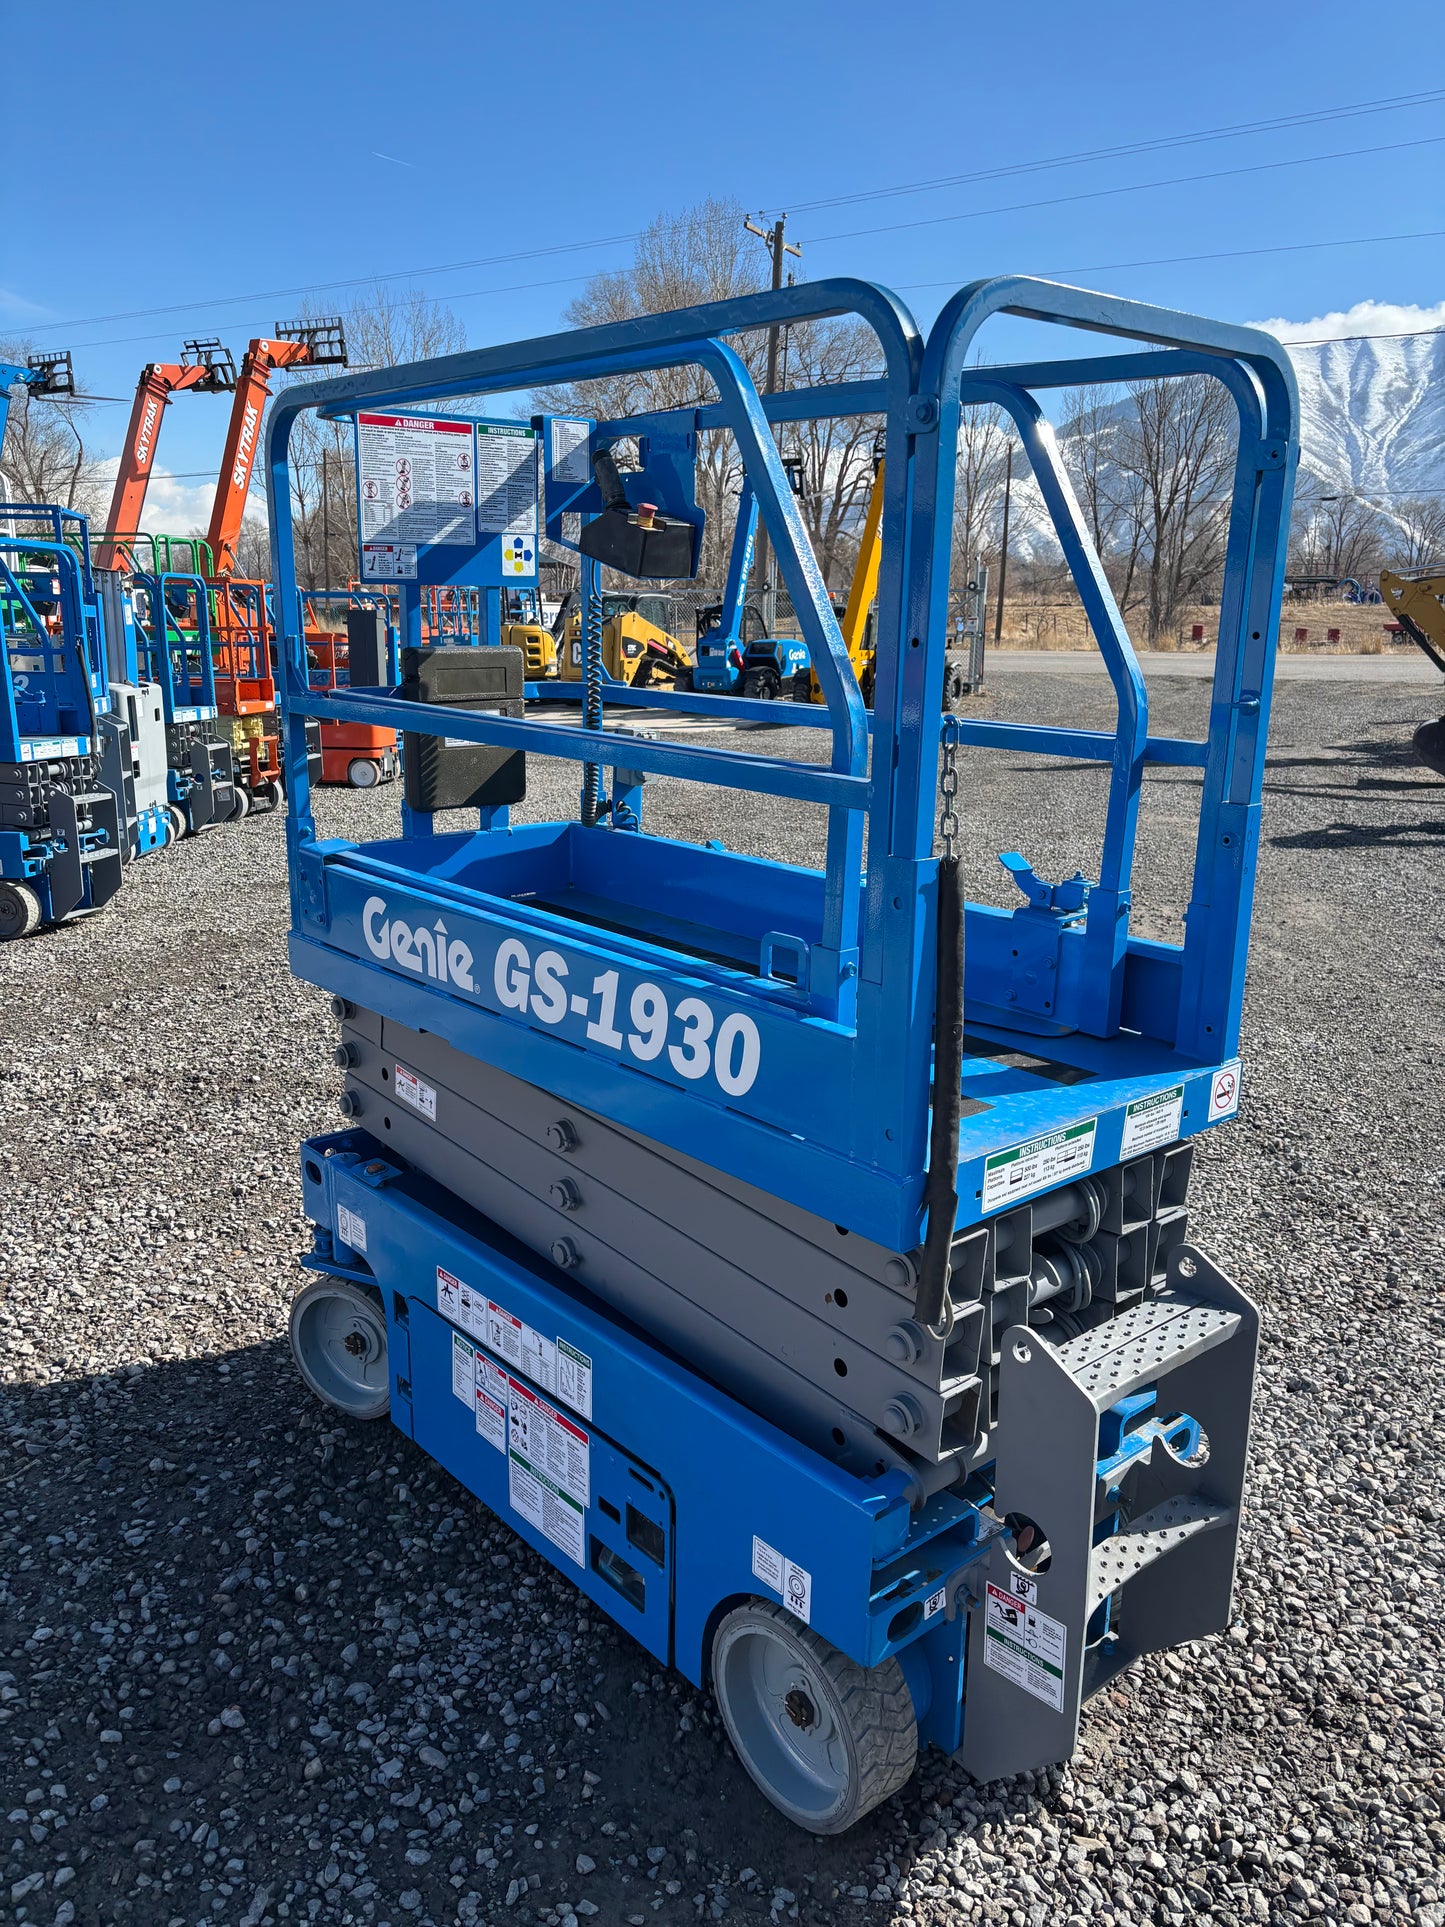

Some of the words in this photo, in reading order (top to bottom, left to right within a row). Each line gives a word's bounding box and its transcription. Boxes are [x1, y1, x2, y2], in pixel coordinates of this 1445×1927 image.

[136, 398, 158, 464] SKYTRAK
[403, 419, 435, 430] DANGER
[487, 427, 526, 437] INSTRUCTIONS
[233, 400, 259, 490] SKYTRAK
[788, 649, 806, 661] Genie
[362, 896, 475, 994] Genie
[493, 938, 761, 1097] GS-1930
[1133, 1089, 1178, 1113] INSTRUCTIONS
[1019, 1132, 1067, 1158] INSTRUCTIONS
[456, 1337, 471, 1355] NOTICE
[559, 1340, 590, 1367] INSTRUCTIONS
[485, 1396, 502, 1415] DANGER
[538, 1401, 558, 1421] DANGER
[530, 1465, 560, 1495] INSTRUCTIONS
[998, 1592, 1022, 1611] DANGER
[1003, 1637, 1044, 1667] INSTRUCTIONS
